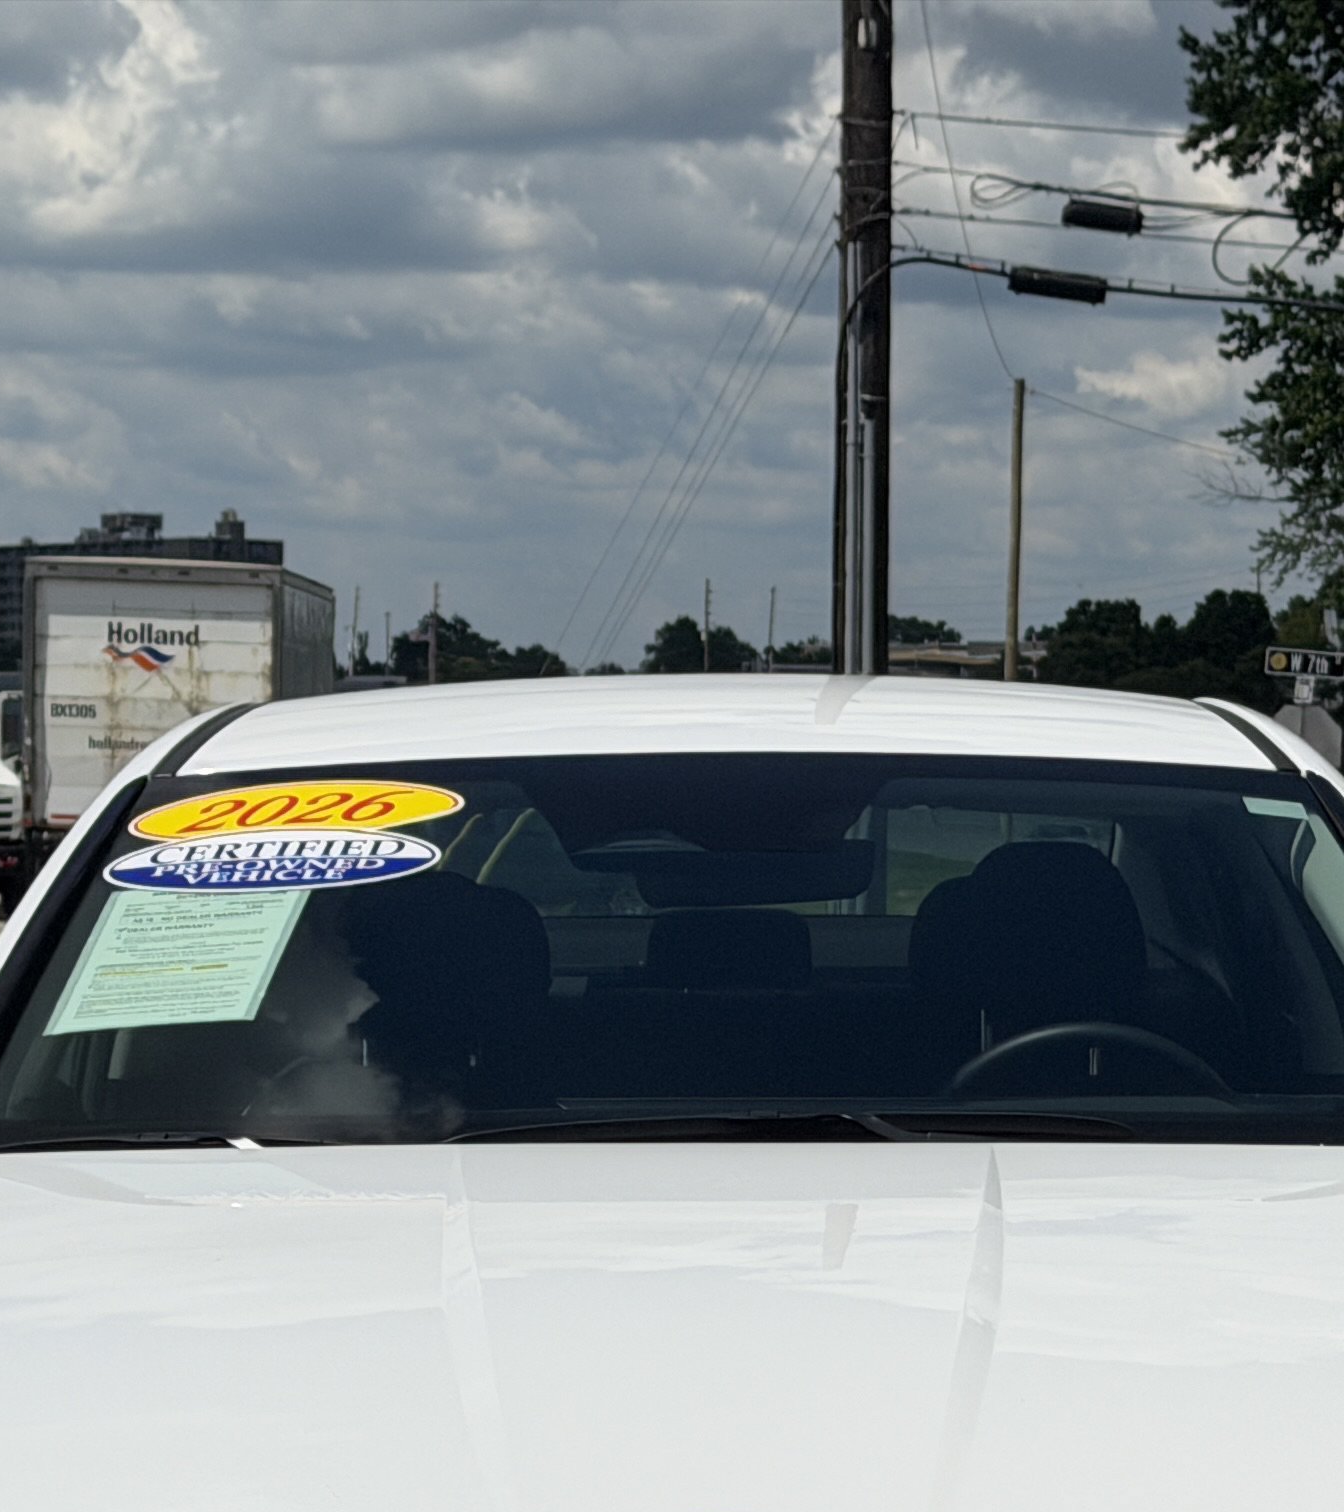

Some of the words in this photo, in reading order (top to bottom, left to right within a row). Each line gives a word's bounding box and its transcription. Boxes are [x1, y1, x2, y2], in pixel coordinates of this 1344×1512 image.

[108, 622, 200, 646] Holland
[1291, 652, 1302, 672] W
[1307, 654, 1329, 674] 7th
[176, 790, 413, 834] 2026
[150, 839, 406, 866] CERTIFIED
[151, 856, 385, 878] PRE-OWNED
[185, 866, 345, 884] VEHICLE
